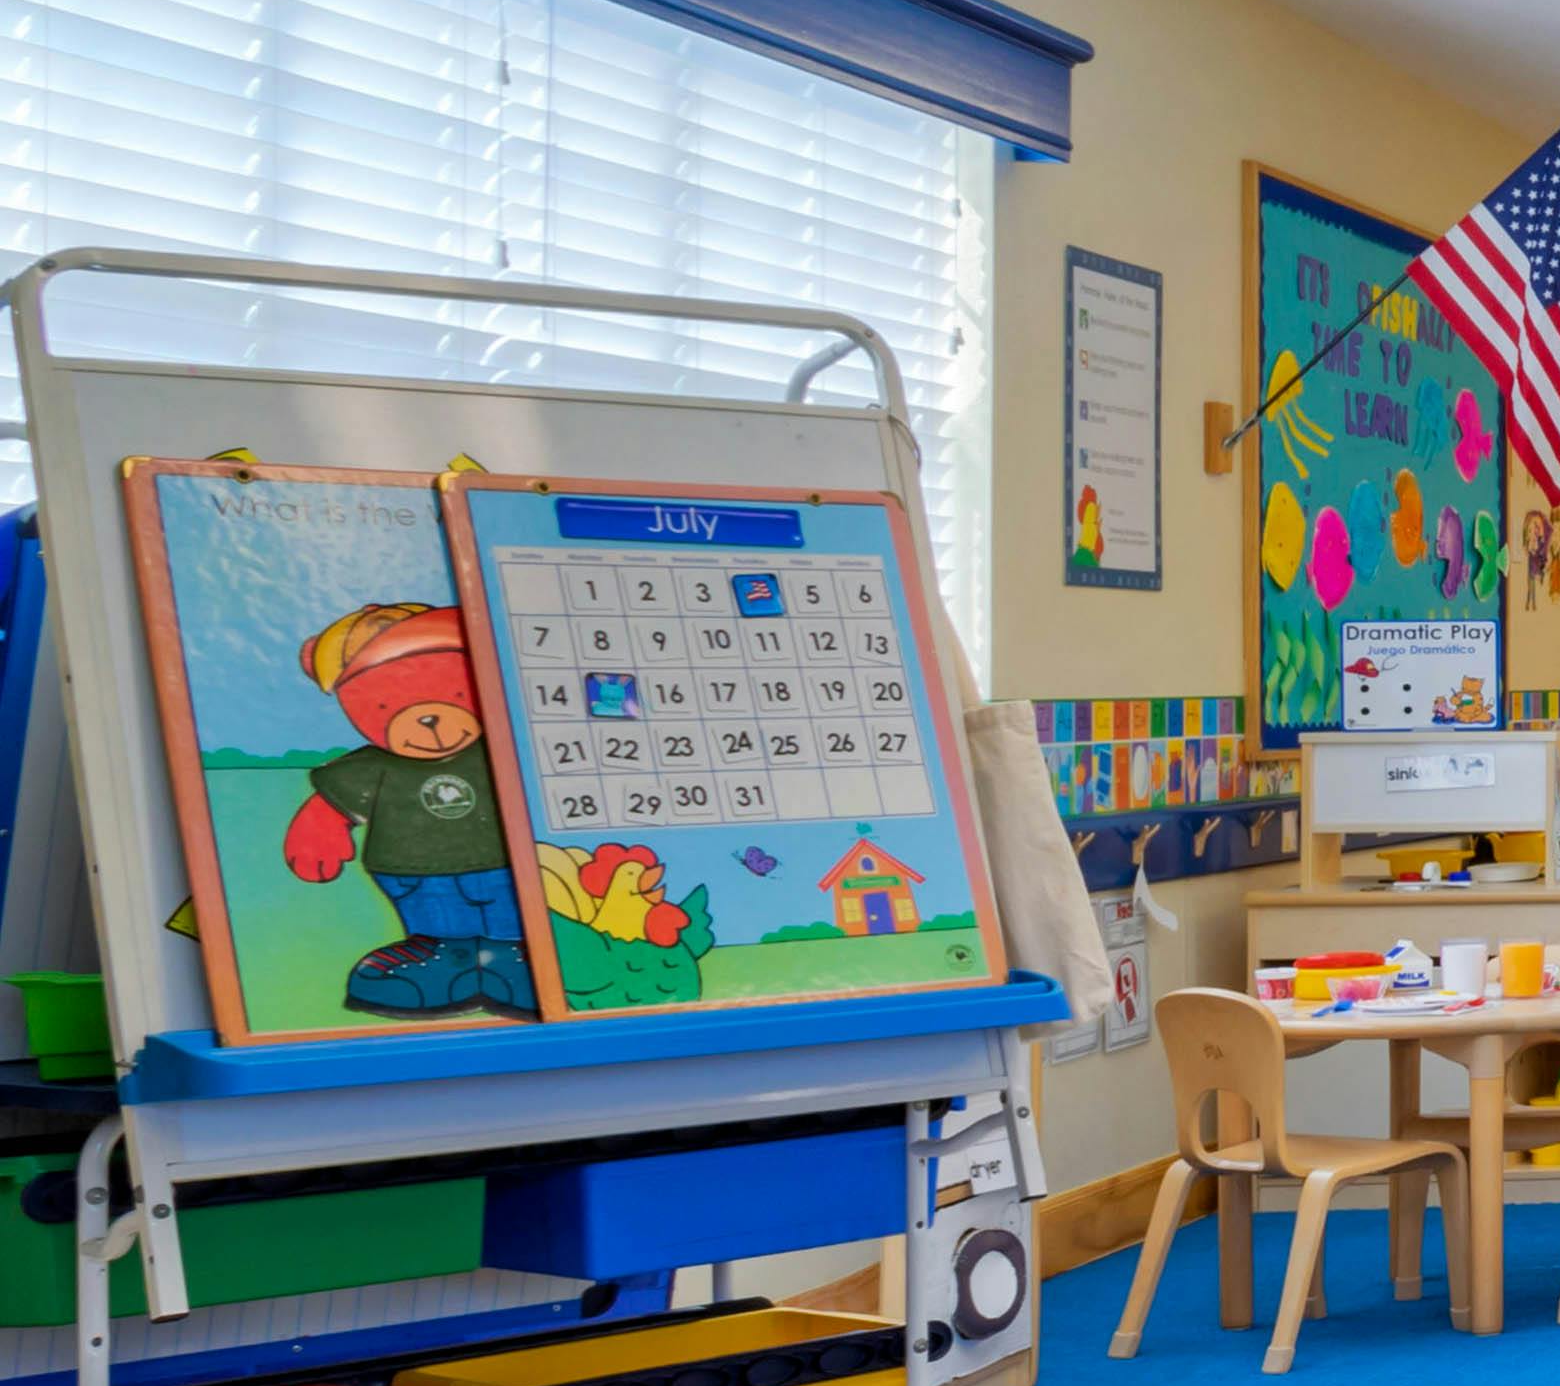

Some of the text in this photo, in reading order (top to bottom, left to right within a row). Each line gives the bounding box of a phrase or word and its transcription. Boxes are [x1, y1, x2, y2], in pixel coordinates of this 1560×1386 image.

[1297, 253, 1330, 308] ITS
[1380, 339, 1412, 387] TO
[1345, 389, 1409, 447] LEARN
[211, 494, 309, 523] What
[324, 498, 346, 524] is
[359, 498, 416, 527] the
[648, 506, 718, 539] July
[585, 581, 871, 604] 1 2 3 5 6
[534, 627, 888, 655] 7 8 9 10 11 12 13
[1346, 625, 1493, 643] Dramatic Play
[1367, 644, 1476, 656] Juego Dramático
[536, 681, 903, 705] 14 16 17 18 19 20
[554, 731, 908, 764] 21 22 23 24 25 26 27
[1387, 764, 1419, 782] sink
[562, 785, 766, 819] 28 29 30 31
[1397, 972, 1425, 981] MILK
[970, 1159, 1002, 1180] dryer
